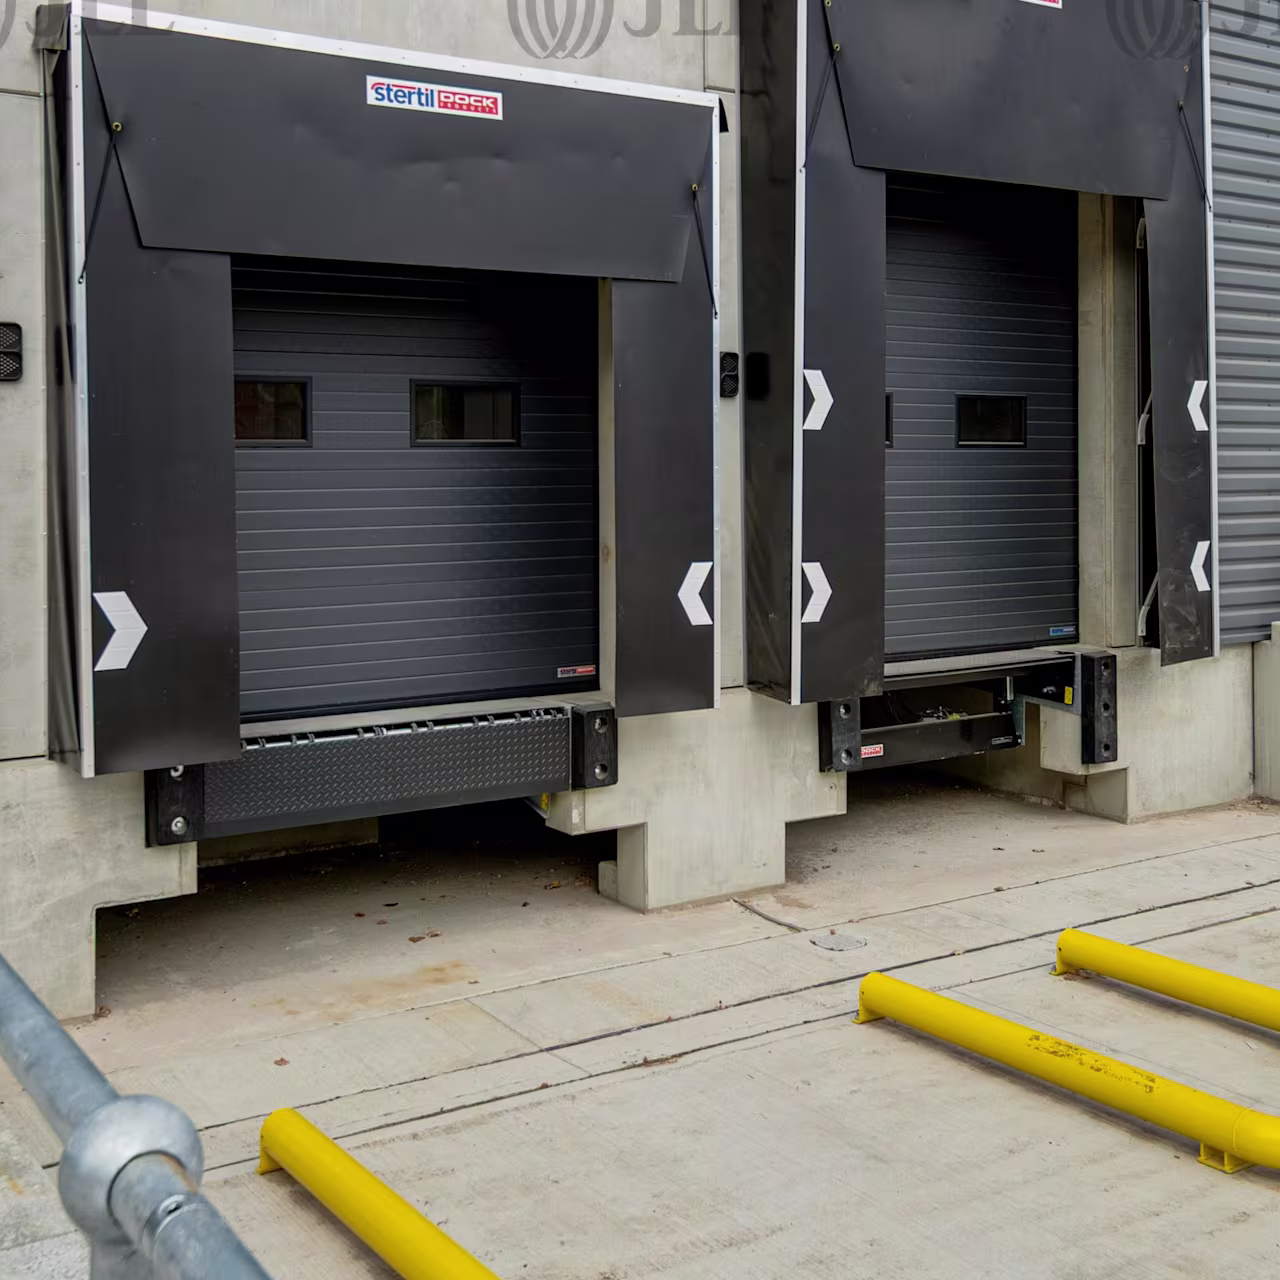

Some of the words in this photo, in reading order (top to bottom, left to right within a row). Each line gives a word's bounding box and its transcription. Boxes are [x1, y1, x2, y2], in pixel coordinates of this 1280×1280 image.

[371, 83, 435, 108] stertil
[440, 92, 495, 108] DOCK
[439, 101, 497, 114] PRODUCTS
